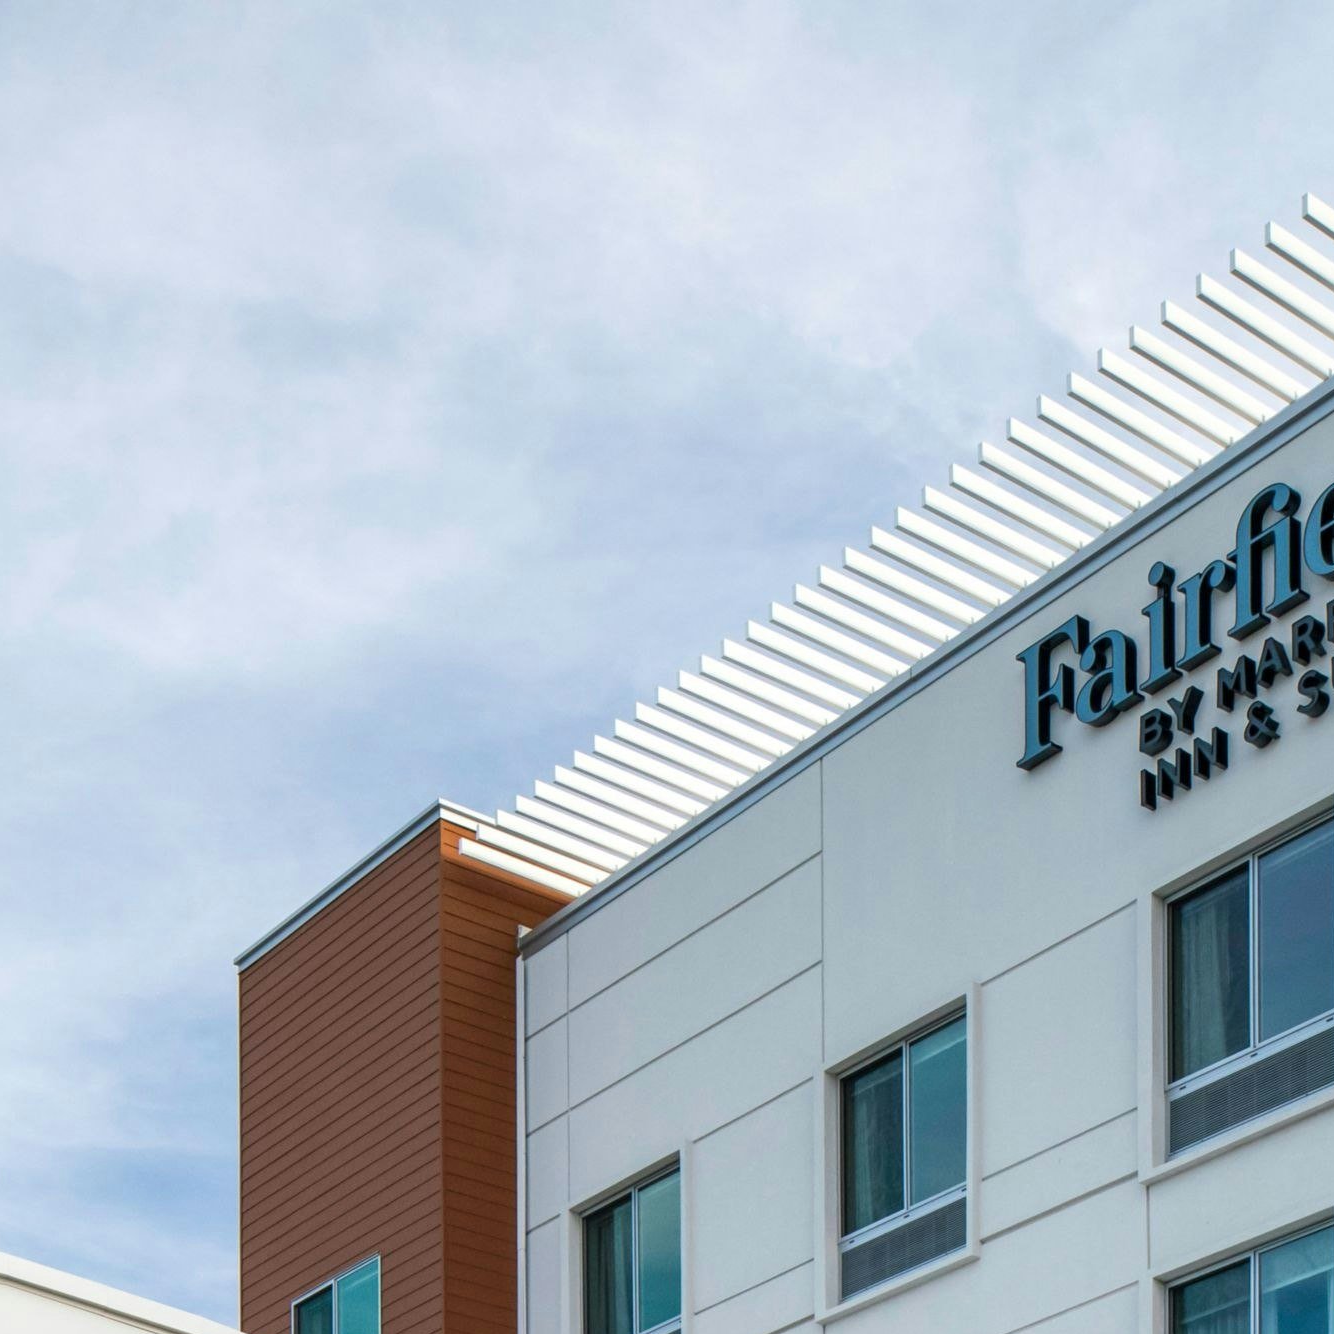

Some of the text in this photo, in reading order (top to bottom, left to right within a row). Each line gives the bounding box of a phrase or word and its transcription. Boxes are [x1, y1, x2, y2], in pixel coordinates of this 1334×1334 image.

[1139, 686, 1204, 756] BY
[1140, 727, 1229, 811] INN
[1243, 700, 1280, 749] &
